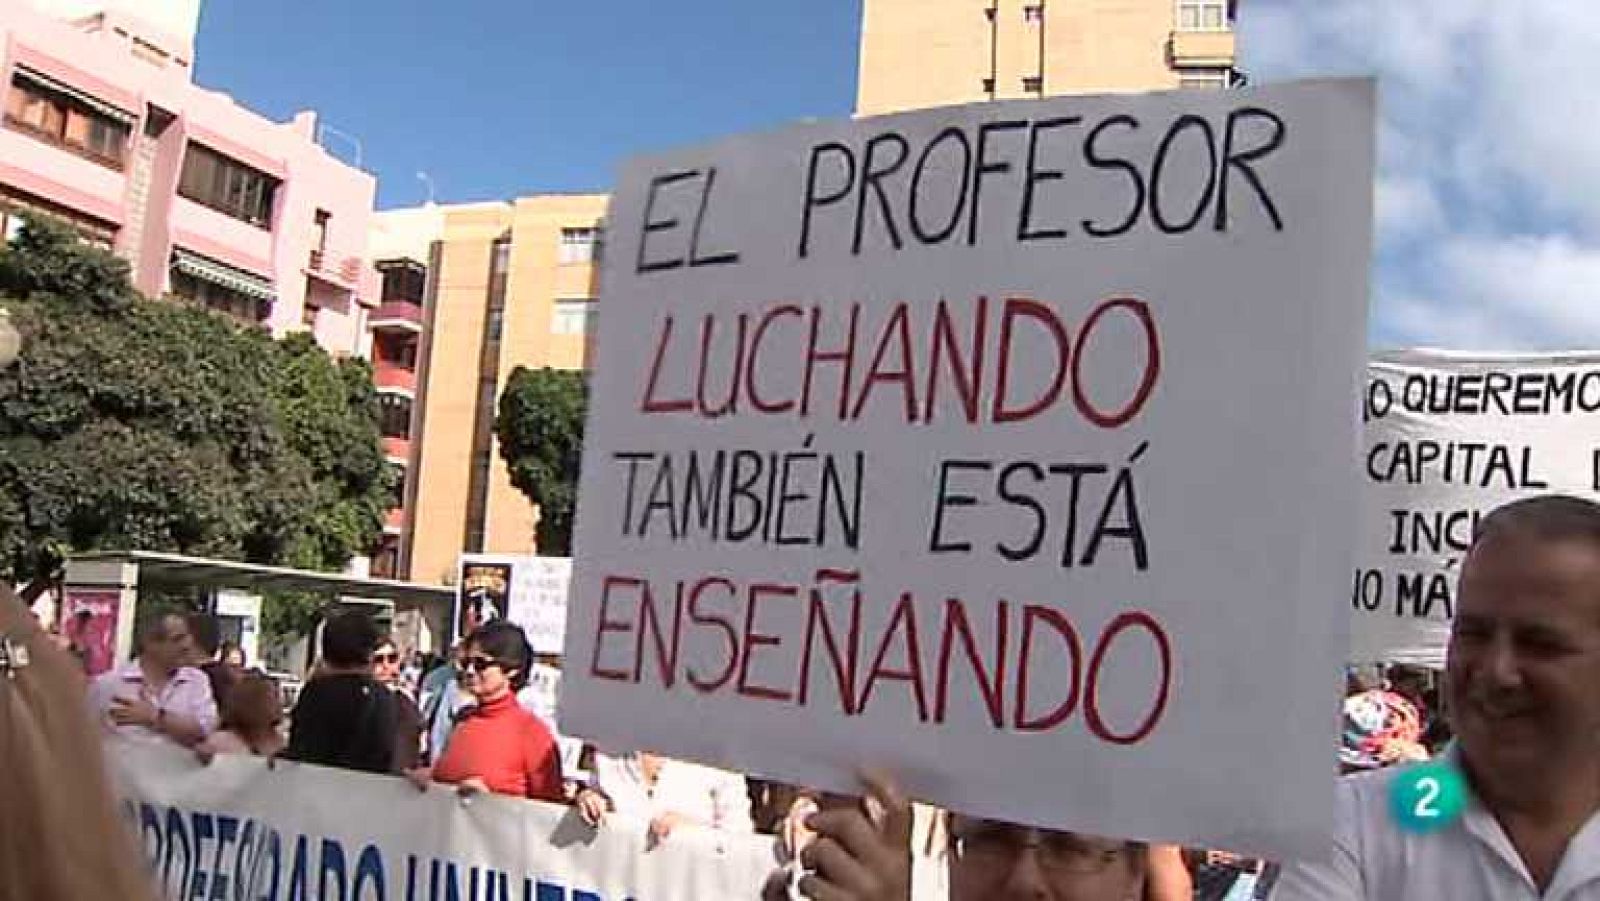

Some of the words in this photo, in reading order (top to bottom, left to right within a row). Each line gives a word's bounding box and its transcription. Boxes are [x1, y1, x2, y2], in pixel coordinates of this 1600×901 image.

[636, 168, 739, 274] EL
[798, 107, 1285, 258] PROFESOR
[642, 296, 1161, 428] LUCHANDO
[613, 434, 864, 550] TAMBIÉN
[929, 442, 1149, 571] ESTÁ
[1367, 441, 1547, 489] CAPITAL
[589, 569, 1172, 746] ENSEÑANDO
